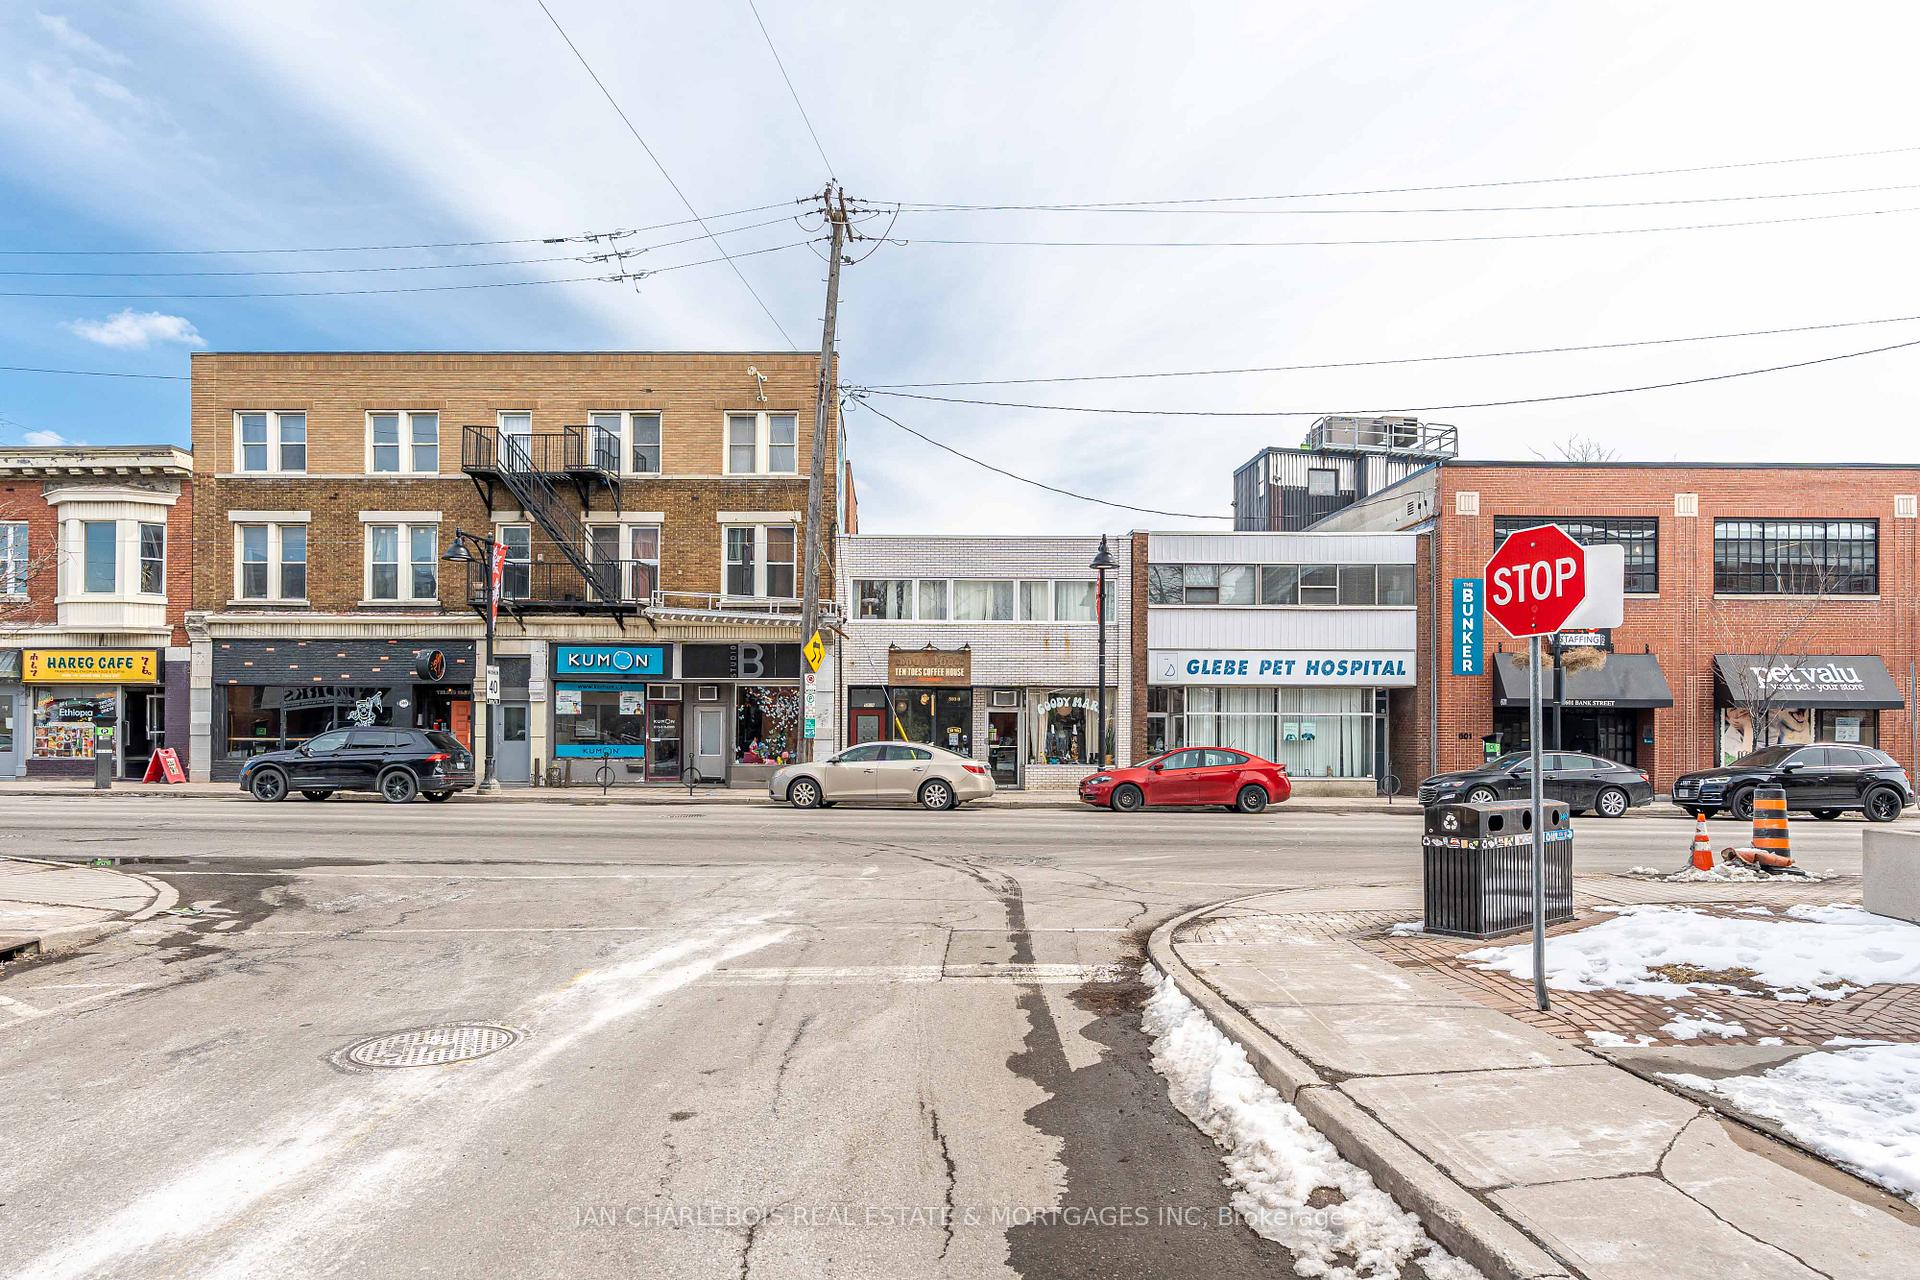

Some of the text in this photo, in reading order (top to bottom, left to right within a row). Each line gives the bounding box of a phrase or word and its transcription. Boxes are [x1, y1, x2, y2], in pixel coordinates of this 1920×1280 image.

[1493, 557, 1577, 606] STOP
[1462, 590, 1474, 672] BUNKER
[47, 657, 134, 669] HAREG CAFE
[568, 650, 649, 670] KUMON
[738, 644, 764, 678] B
[1186, 659, 1406, 676] GLEBE PET HOSPITAL
[895, 667, 965, 678] TEN TOES COFFEE HOUSE
[1750, 663, 1863, 689] pet valu
[489, 680, 498, 694] 40
[1770, 684, 1792, 692] your
[1795, 682, 1811, 692] pet
[1815, 684, 1838, 692] your
[1038, 696, 1071, 715] GOODY
[59, 709, 93, 720] Ethiopia
[583, 747, 619, 757] KUMON
